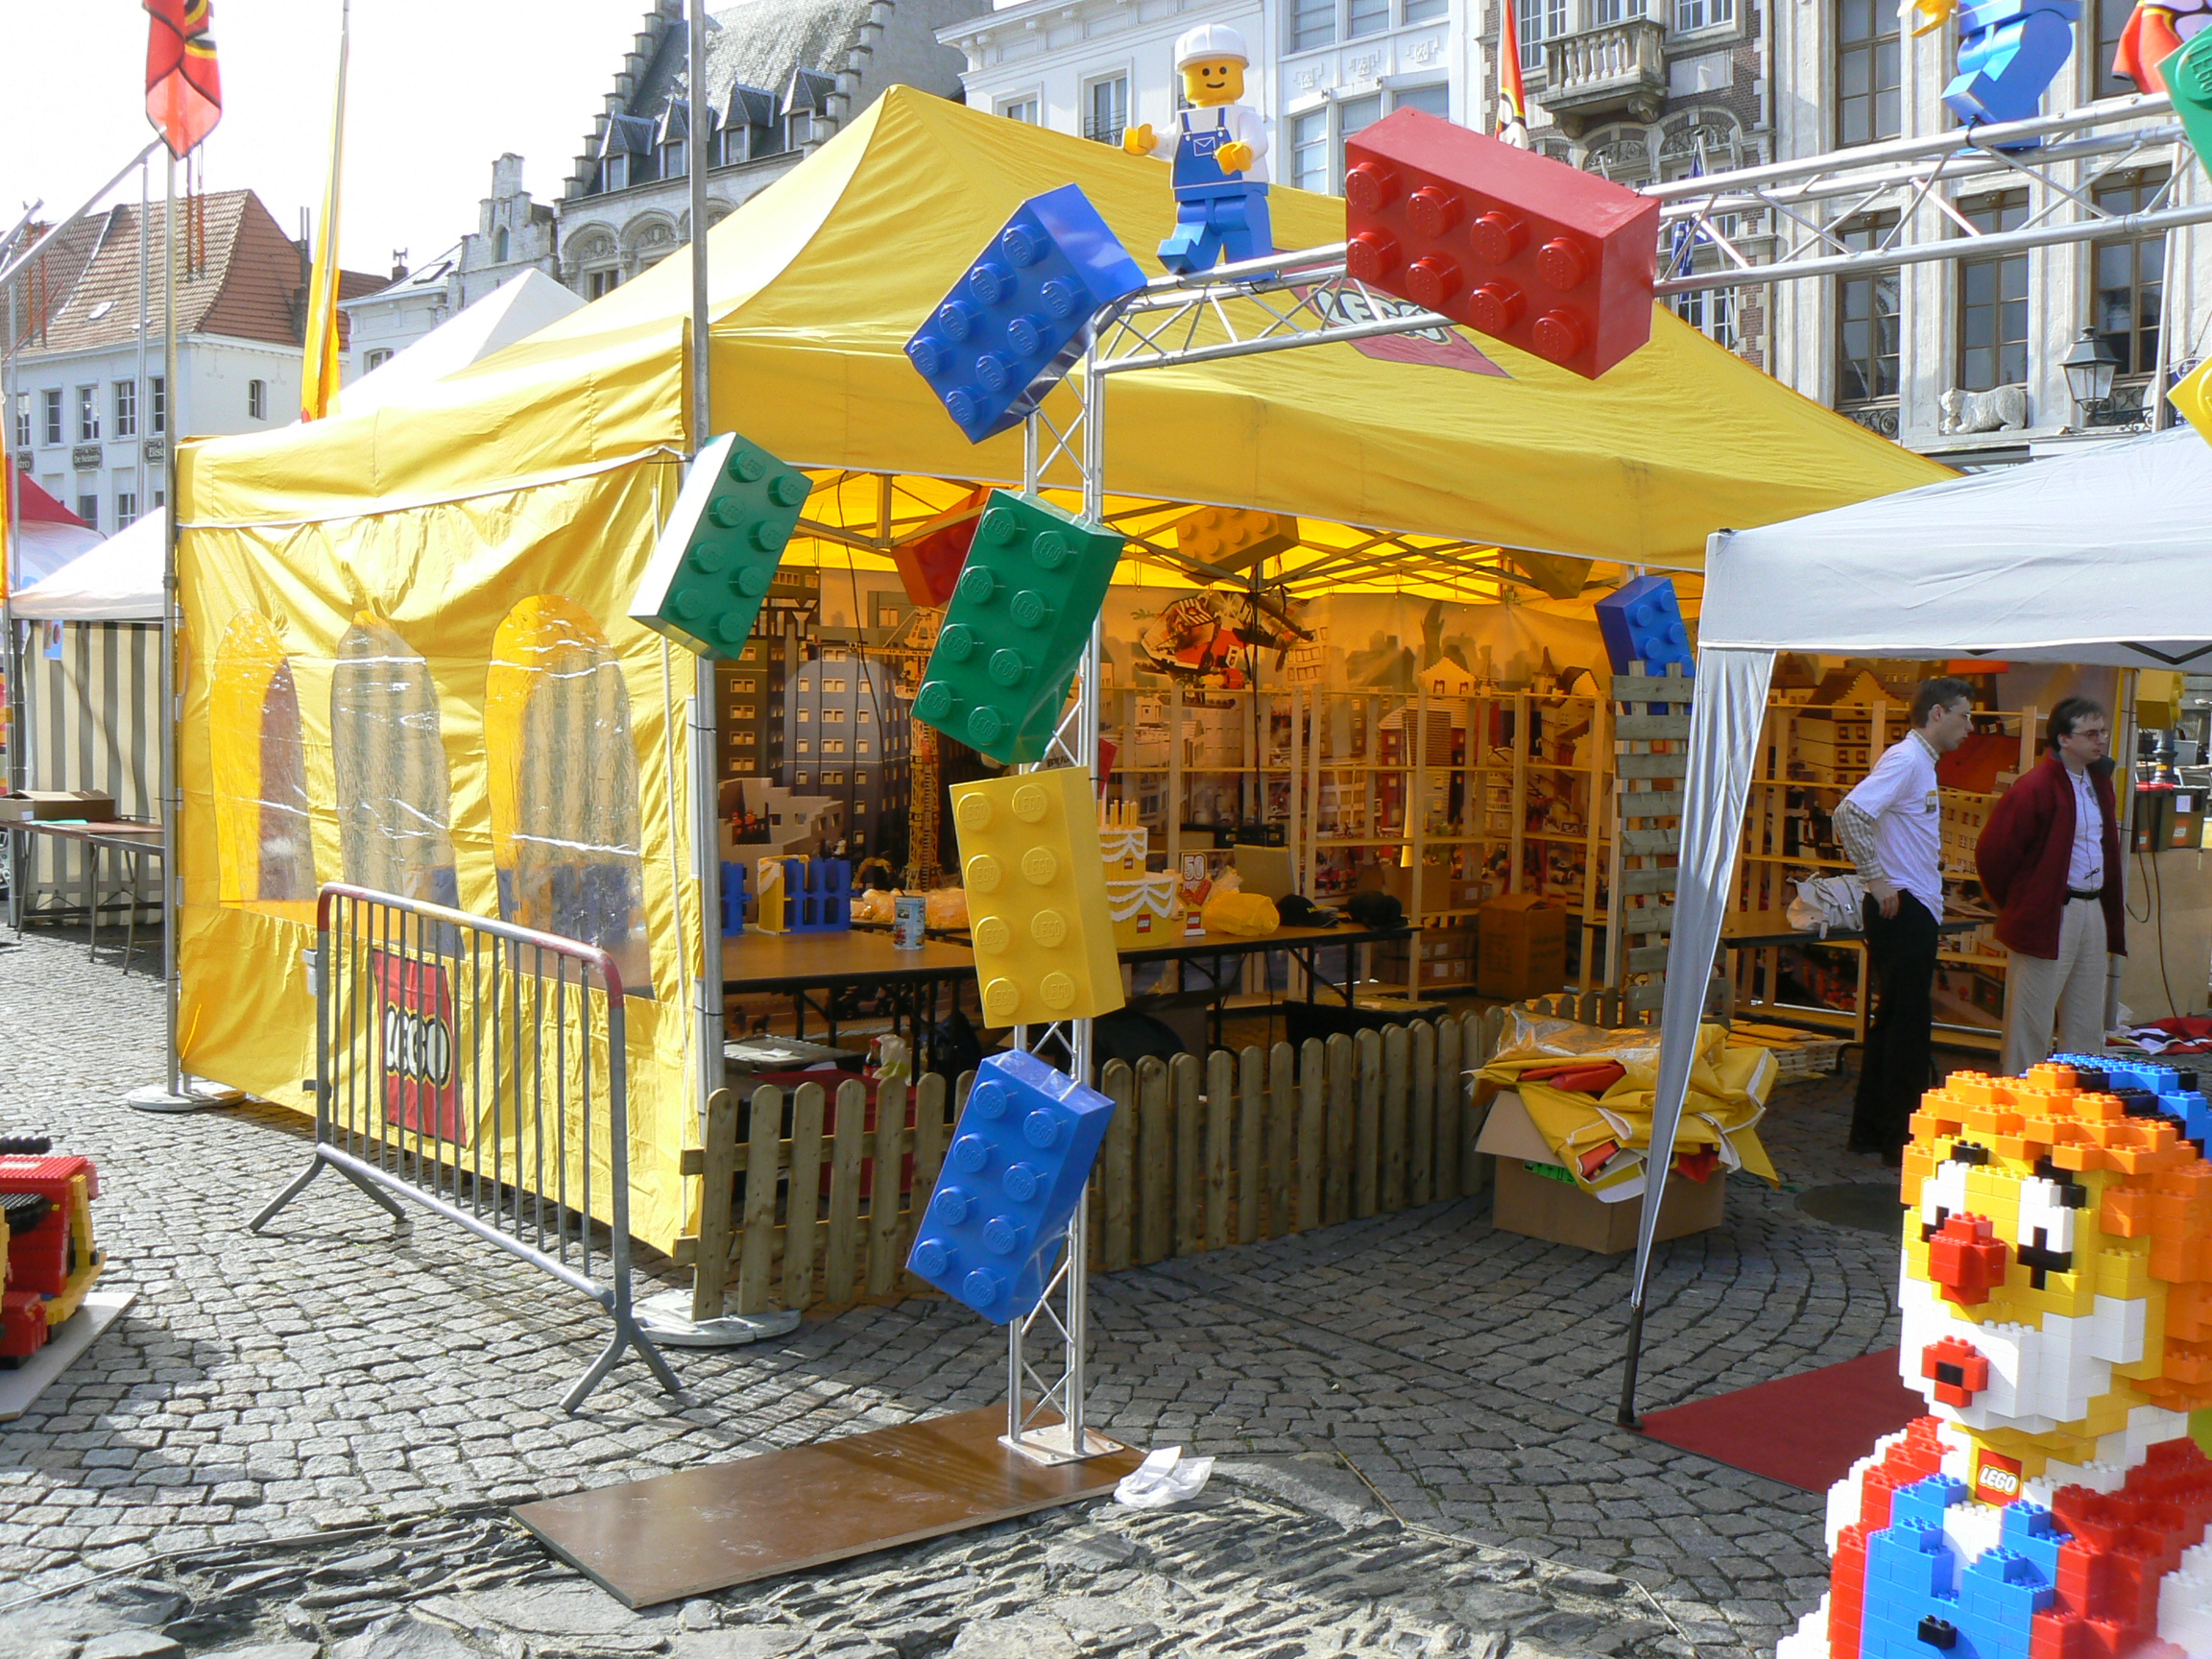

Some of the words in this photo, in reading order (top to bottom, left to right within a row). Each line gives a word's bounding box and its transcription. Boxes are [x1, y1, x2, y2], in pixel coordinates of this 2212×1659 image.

[1003, 233, 1029, 261] LEGO
[971, 273, 998, 301] LEGO
[1040, 287, 1068, 315] LEGO
[940, 310, 964, 337] LEGO
[1008, 325, 1034, 352] LEGO
[909, 347, 934, 373] LEGO
[975, 361, 1001, 388] LEGO
[946, 397, 971, 423] LEGO
[983, 515, 1011, 538] LEGO
[1034, 539, 1062, 562] LEGO
[961, 573, 989, 596] LEGO
[1012, 597, 1040, 620] LEGO
[941, 632, 968, 654] LEGO
[990, 655, 1018, 679] LEGO
[920, 688, 948, 711] LEGO
[970, 713, 997, 736] LEGO
[962, 803, 987, 823] LEGO
[1017, 794, 1044, 816] LEGO
[971, 864, 995, 884] LEGO
[1026, 857, 1052, 878] LEGO
[1184, 854, 1205, 880] 50
[980, 927, 1005, 947] LEGO
[1036, 920, 1062, 940] LEGO
[989, 990, 1015, 1008] LEGO
[1045, 982, 1071, 1002] LEGO
[383, 1008, 448, 1082] LEGO
[975, 1090, 1002, 1114] LEGO
[1025, 1118, 1052, 1142] LEGO
[956, 1142, 982, 1166] LEGO
[1005, 1172, 1032, 1197] LEGO
[936, 1194, 962, 1218] LEGO
[985, 1225, 1011, 1249] LEGO
[917, 1247, 945, 1271] LEGO
[965, 1279, 992, 1303] LEGO
[1979, 1466, 2017, 1494] LEGO
